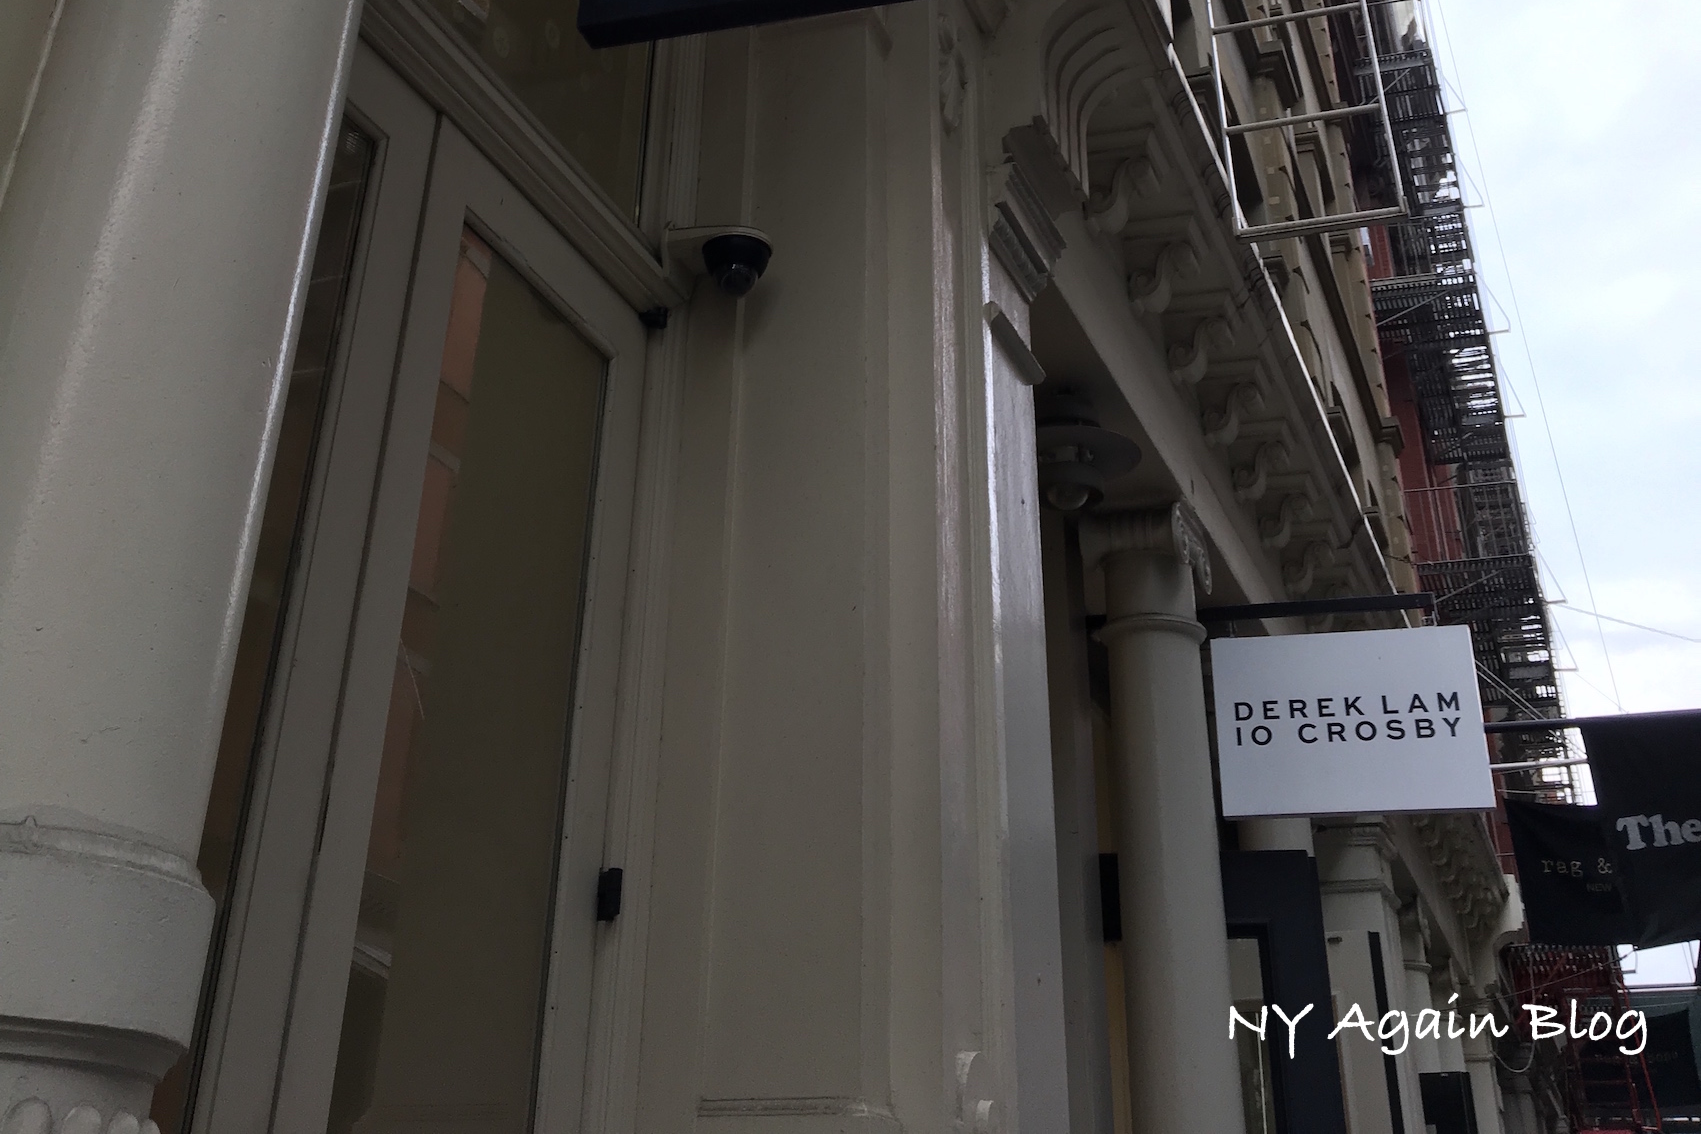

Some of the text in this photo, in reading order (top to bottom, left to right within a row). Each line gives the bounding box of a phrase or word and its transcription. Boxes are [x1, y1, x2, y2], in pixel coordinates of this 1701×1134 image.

[1233, 691, 1461, 722] DEREK LAM
[1297, 716, 1462, 745] CROSBY
[1615, 814, 1701, 851] The
[1541, 857, 1614, 878] rag &
